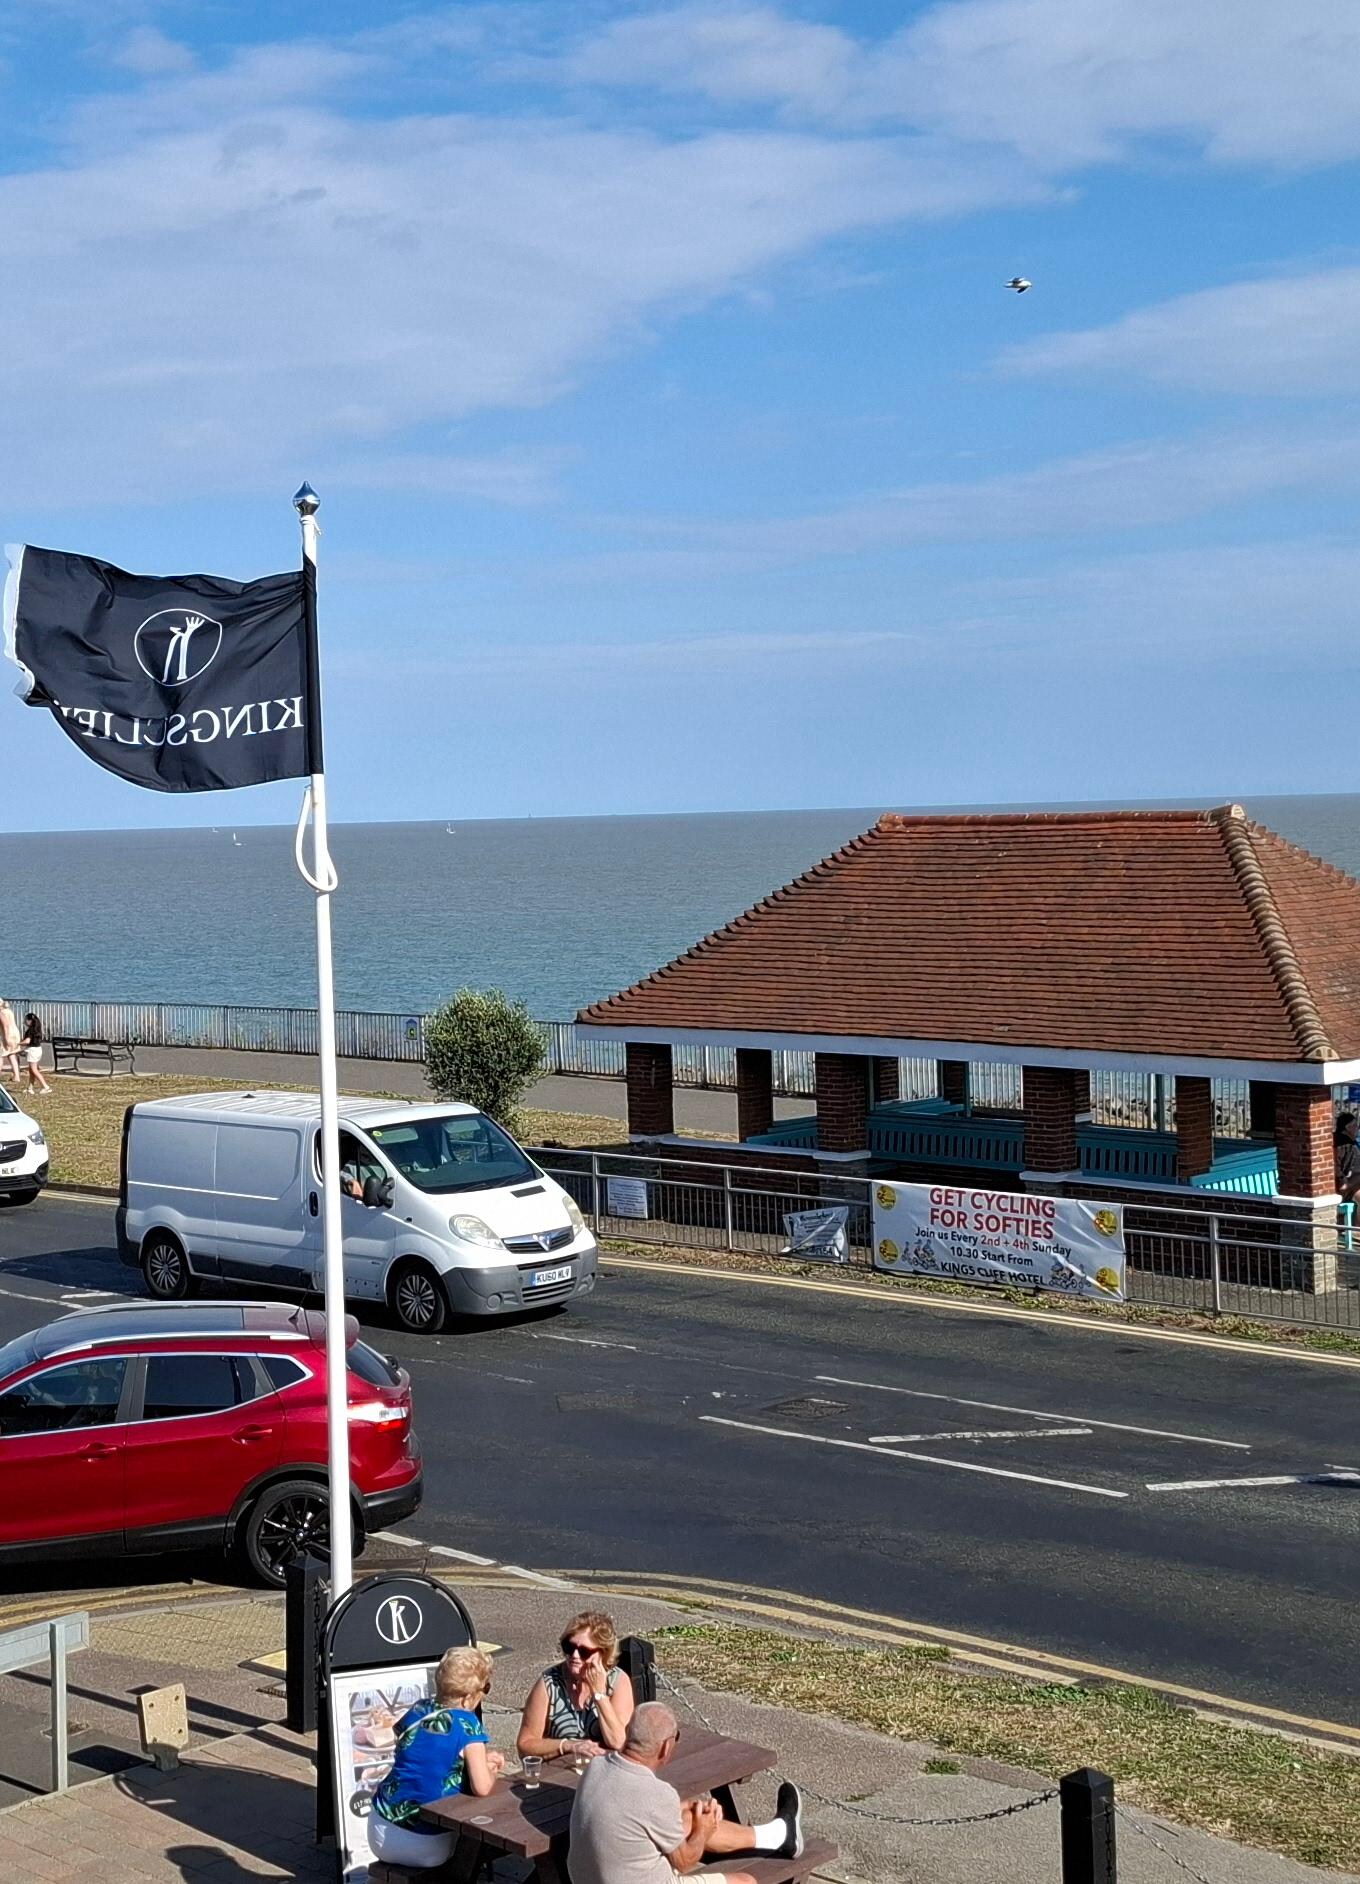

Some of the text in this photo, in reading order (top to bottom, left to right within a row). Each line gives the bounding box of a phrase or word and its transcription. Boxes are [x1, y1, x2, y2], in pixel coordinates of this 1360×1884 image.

[929, 1187, 1056, 1219] GET CYCLING
[930, 1207, 1054, 1240] FOR SOFTIES
[915, 1227, 935, 1238] Join
[938, 1232, 949, 1240] us
[951, 1231, 978, 1246] Every
[981, 1235, 1000, 1247] 2nd
[1012, 1239, 1029, 1251] 4th
[1032, 1241, 1071, 1259] Sunday
[981, 1250, 1006, 1263] Start
[1007, 1254, 1033, 1267] From
[941, 1262, 1047, 1286] KINGS CLIFF HOTEL
